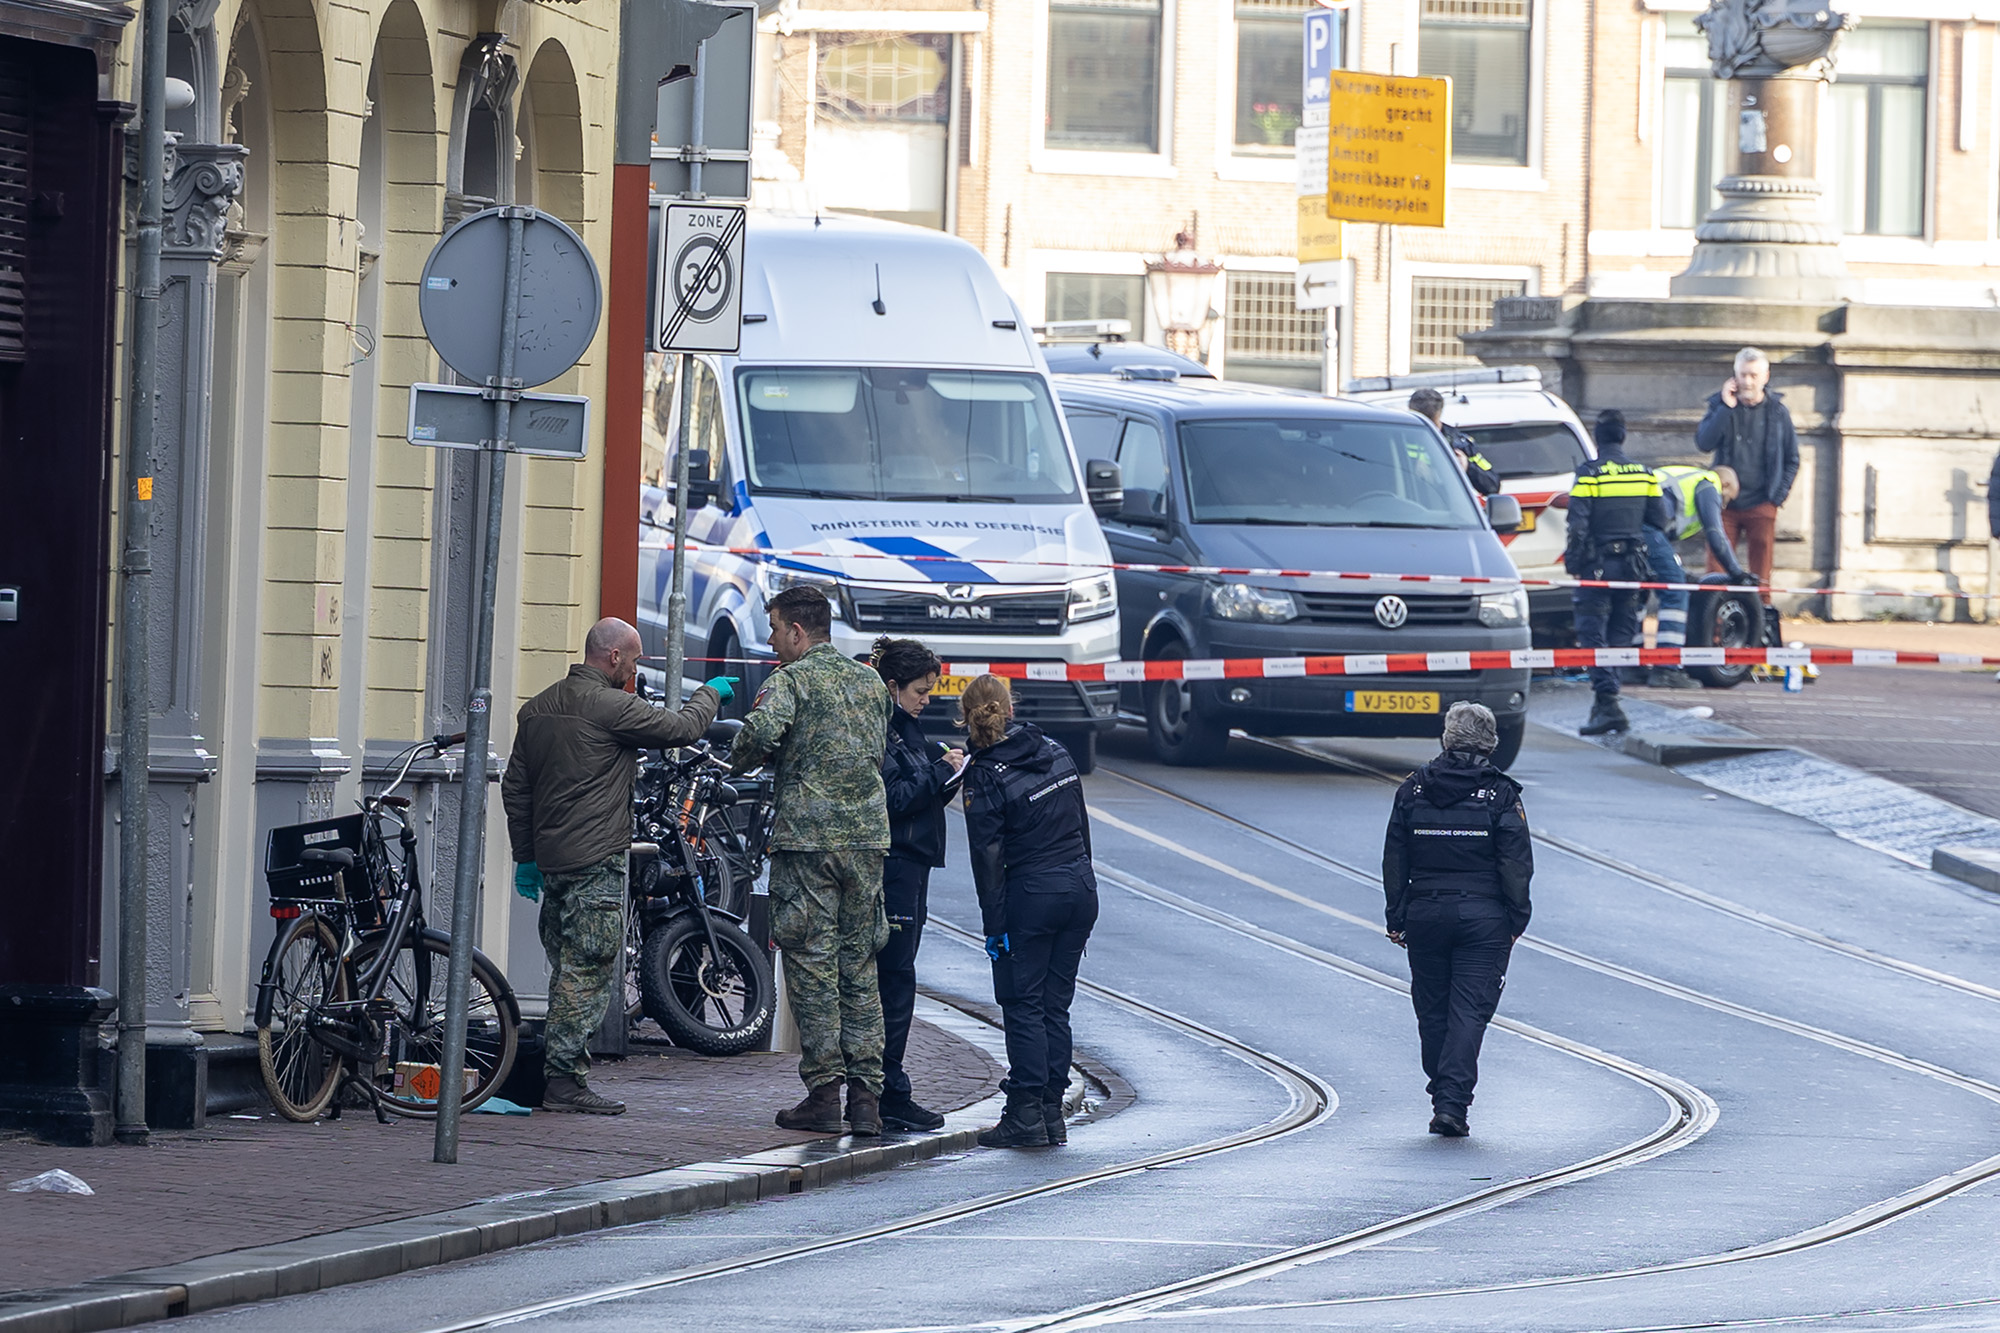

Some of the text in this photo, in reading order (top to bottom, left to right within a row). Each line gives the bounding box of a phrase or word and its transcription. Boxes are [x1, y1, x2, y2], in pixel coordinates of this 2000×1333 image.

[1311, 18, 1329, 69] P
[1385, 83, 1435, 99] Heren-
[1386, 106, 1432, 123] gracht
[1331, 122, 1404, 142] afgesloten
[1333, 146, 1379, 163] Amstel
[1332, 168, 1431, 190] bereikbaar via
[1331, 191, 1429, 214] Waterlooplein
[688, 214, 723, 228] ZONE
[684, 263, 722, 294] 30
[811, 520, 1066, 537] MINISTERIE VAN DEFENSIE
[928, 605, 991, 619] MAN
[1363, 694, 1431, 710] VJ-510-S
[718, 1007, 768, 1040] REXWAY
